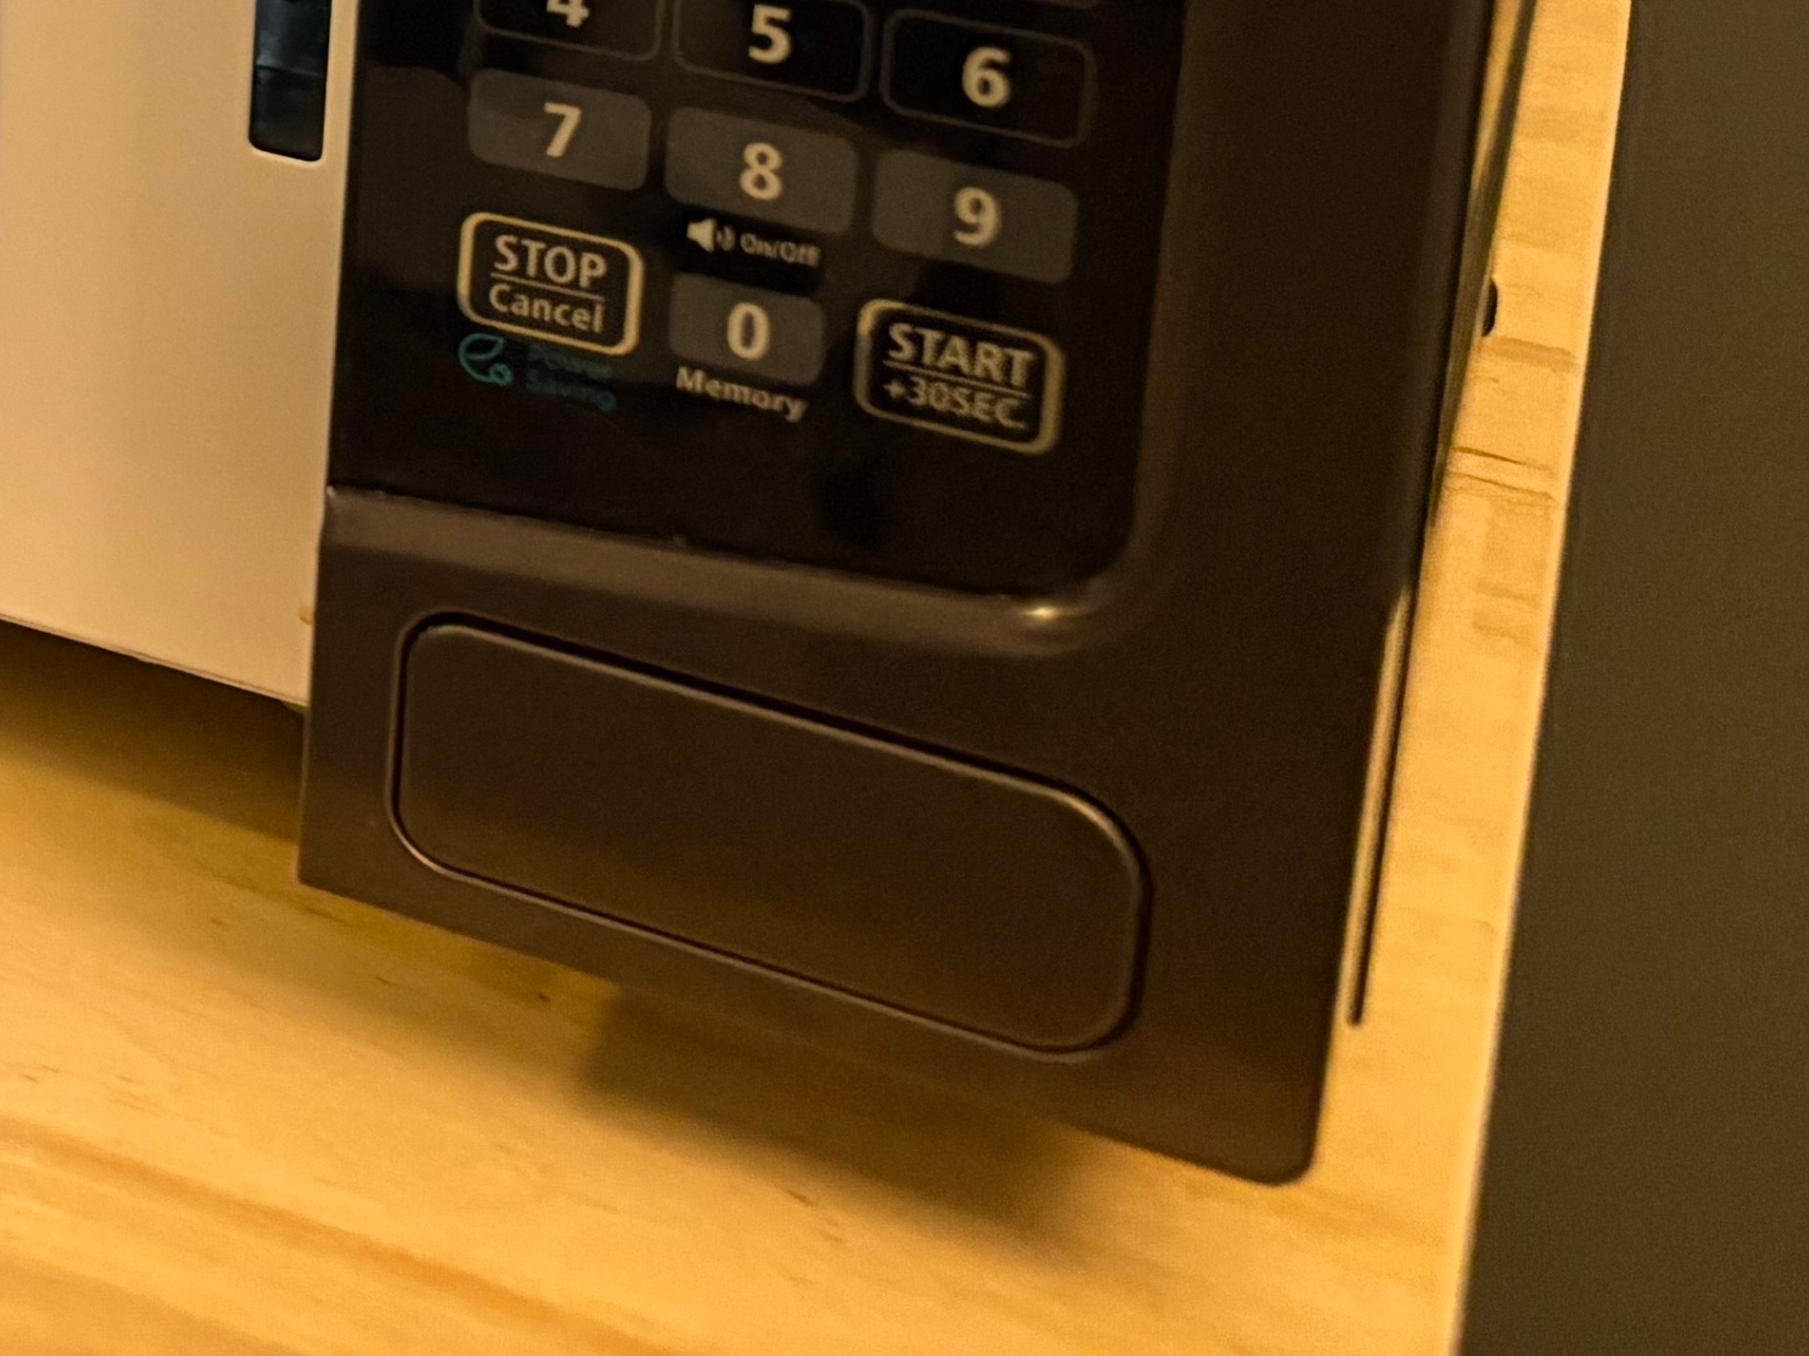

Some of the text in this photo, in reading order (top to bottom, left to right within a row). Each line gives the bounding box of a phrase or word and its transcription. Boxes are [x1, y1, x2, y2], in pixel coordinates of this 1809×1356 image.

[749, 6, 792, 64] 5
[961, 48, 1012, 109] 6
[542, 103, 581, 157] 7
[739, 143, 782, 203] 8
[953, 189, 1000, 247] 9
[494, 234, 607, 290] STOP
[489, 284, 605, 335] Cancel
[727, 303, 771, 360] 0
[888, 321, 1035, 390] START
[677, 368, 806, 423] Memory
